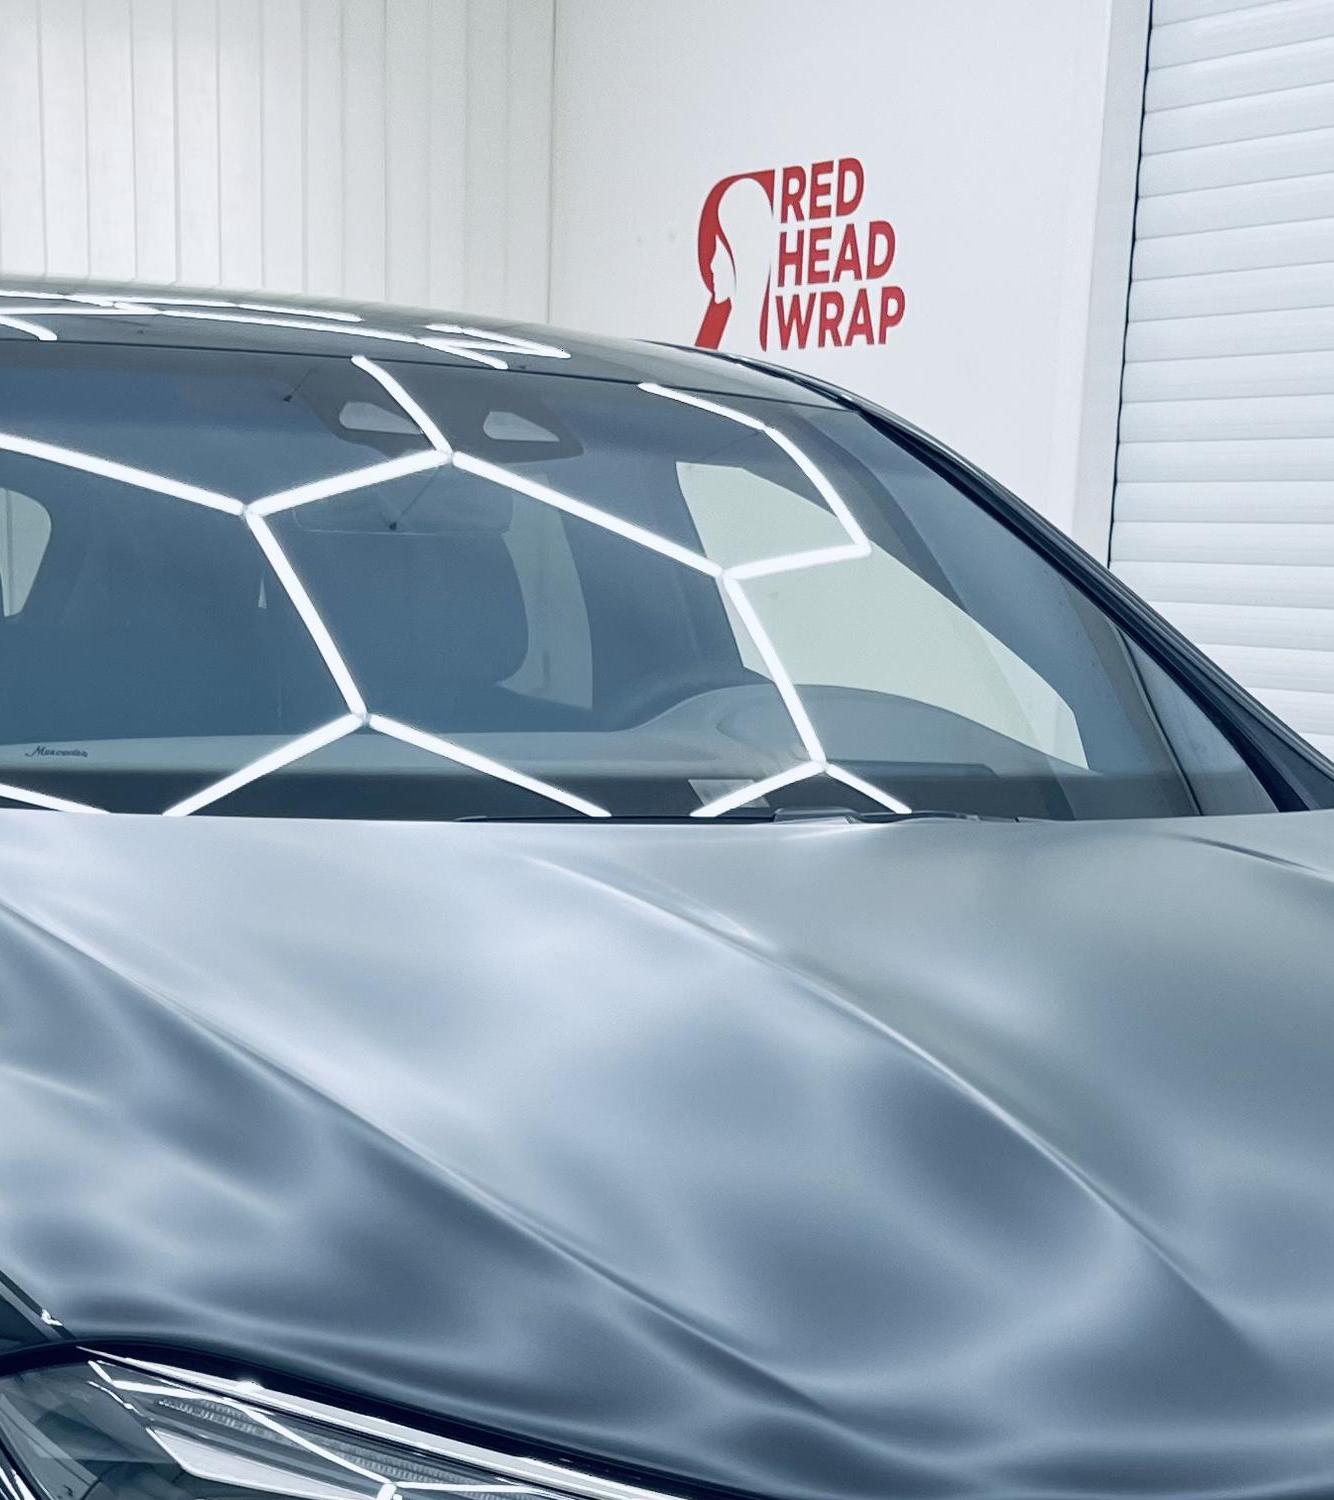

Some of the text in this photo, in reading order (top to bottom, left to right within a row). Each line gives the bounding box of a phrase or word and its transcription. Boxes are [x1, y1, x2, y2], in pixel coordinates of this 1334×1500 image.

[780, 157, 865, 224] RED
[777, 220, 896, 288] HEAD
[775, 286, 906, 351] WRAP
